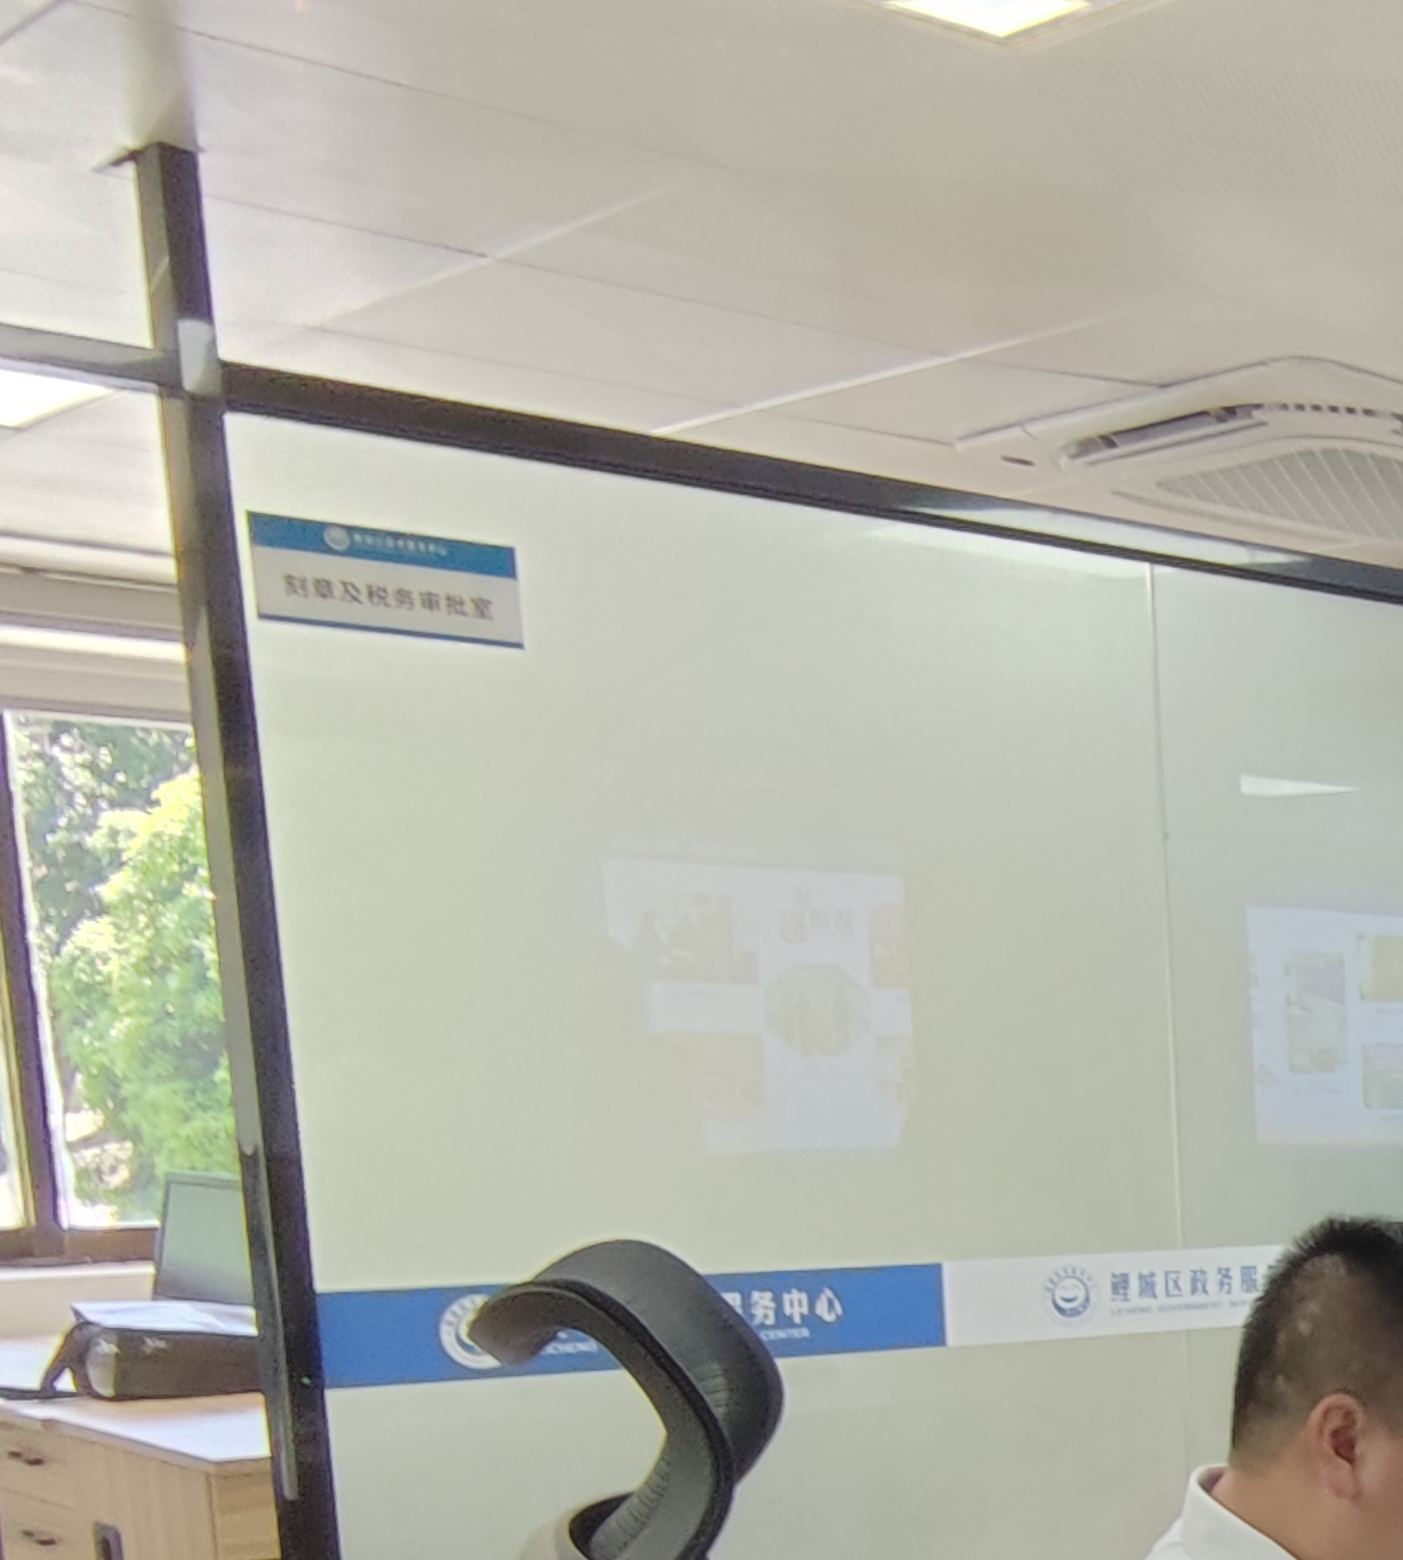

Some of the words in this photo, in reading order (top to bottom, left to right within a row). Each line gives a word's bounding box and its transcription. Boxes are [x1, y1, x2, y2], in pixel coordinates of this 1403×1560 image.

[282, 574, 495, 621] 刻章及税务审批室
